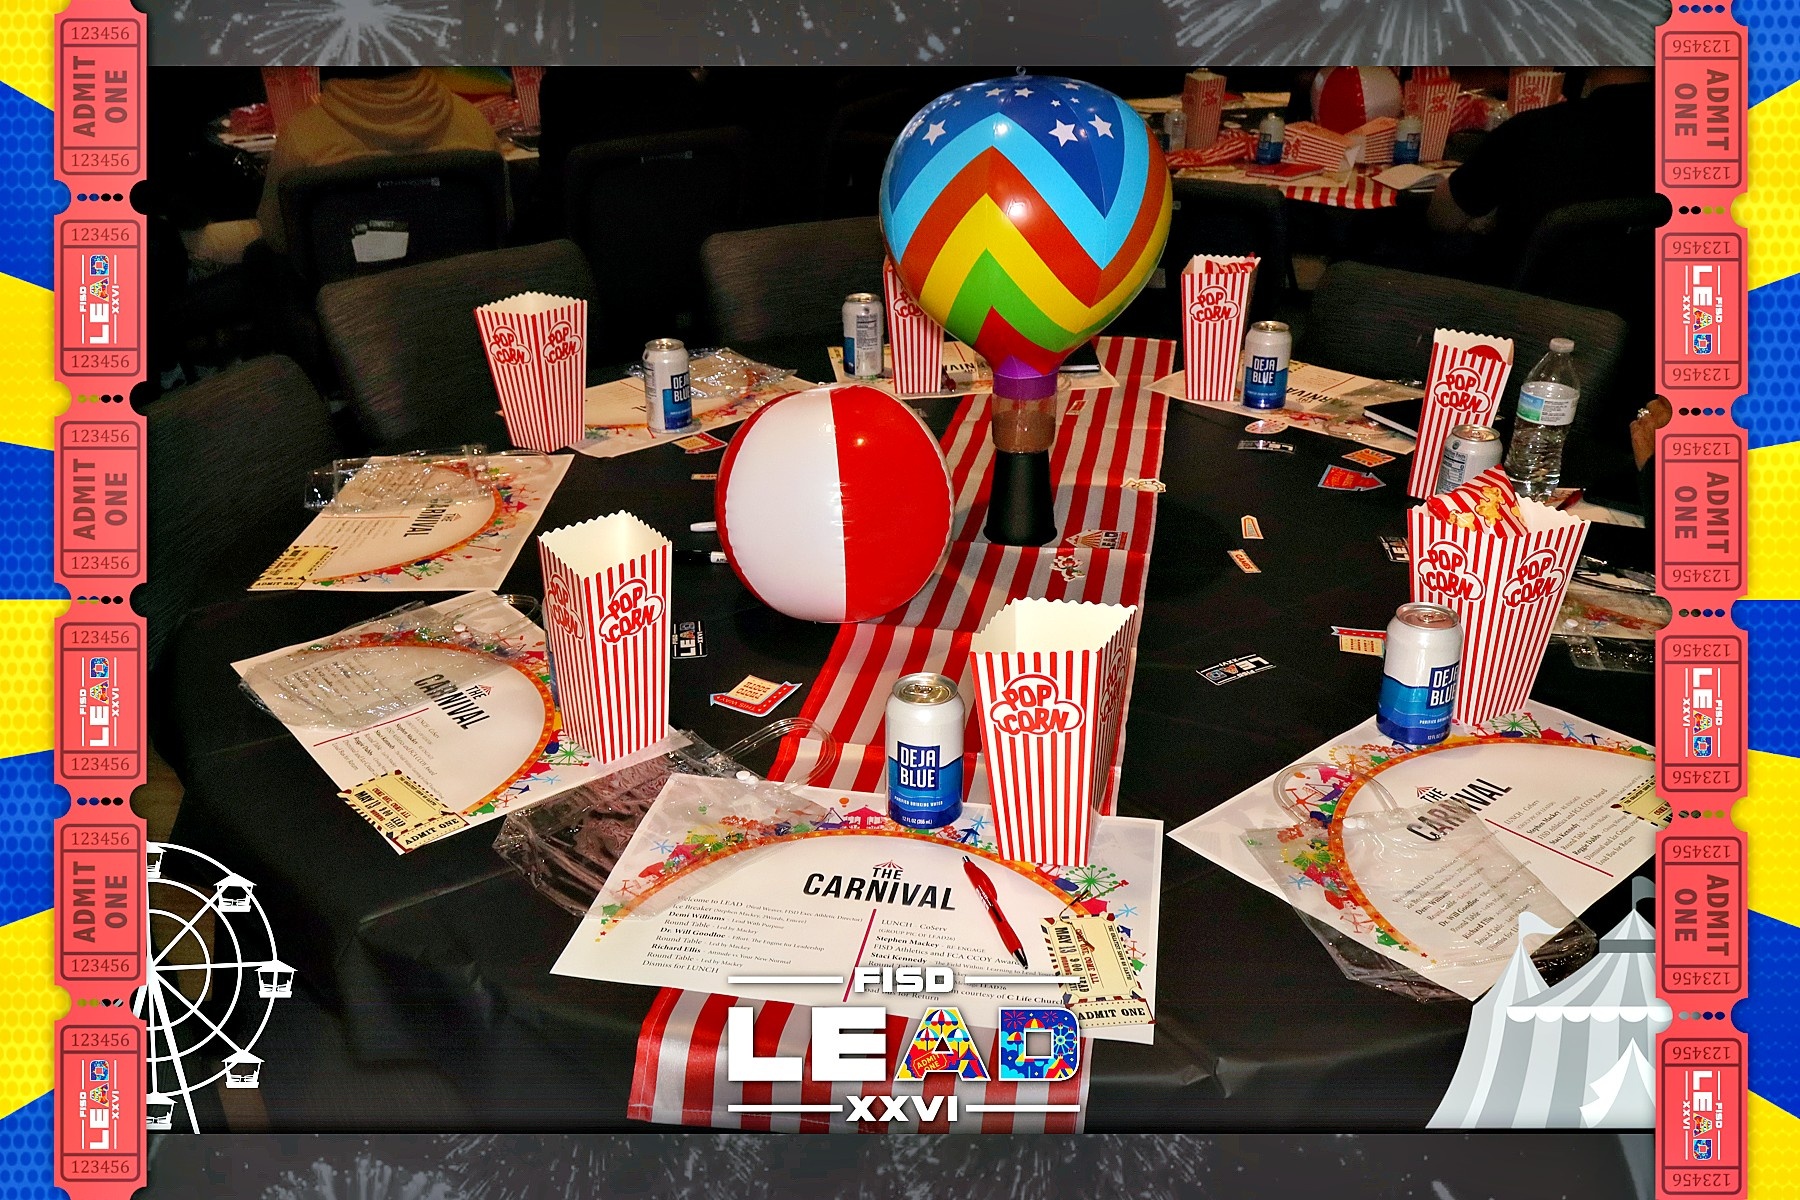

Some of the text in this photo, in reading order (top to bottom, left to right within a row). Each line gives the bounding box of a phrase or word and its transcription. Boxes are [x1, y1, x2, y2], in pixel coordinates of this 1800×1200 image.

[1197, 292, 1224, 308] POP
[1196, 305, 1232, 322] CORN
[493, 333, 514, 349] POP
[548, 327, 569, 347] POP
[496, 348, 525, 364] CORN
[549, 341, 577, 364] CORN
[1254, 358, 1275, 371] DEJA
[1252, 371, 1274, 384] BLUE
[1445, 374, 1477, 392] POP
[1440, 391, 1485, 414] CORN
[1427, 549, 1463, 572] POP
[1517, 557, 1552, 585] POP
[1426, 571, 1474, 600] CORN
[1510, 577, 1557, 607] CORN
[608, 586, 643, 620] POP
[608, 605, 655, 643] CORN
[680, 621, 696, 656] LEAD
[1205, 657, 1269, 680] LEAD
[465, 685, 487, 700] THE
[1002, 684, 1052, 711] POP
[413, 673, 490, 730] CARNIVAL
[1003, 708, 1070, 735] CORN
[901, 746, 935, 767] DEJA
[901, 766, 935, 788] BLUE
[354, 790, 374, 804] MAY
[1420, 788, 1448, 804] THE
[1407, 778, 1512, 841] CARNIVAL
[405, 818, 460, 845] ADMIT ONE
[872, 867, 903, 880] THE
[803, 873, 955, 911] CARNIVAL
[685, 904, 712, 912] Breaker
[720, 899, 743, 907] LEAD
[692, 913, 725, 921] Williams
[881, 919, 913, 927] LUNCH
[683, 937, 702, 945] Table
[692, 930, 726, 938] Goodloe
[875, 935, 940, 948] Stephen Mackey
[1055, 926, 1073, 944] MAY
[647, 951, 673, 959] Round
[651, 943, 682, 951] Richard
[873, 943, 894, 951] FISD
[895, 946, 929, 955] Athletics
[892, 954, 928, 964] Kennedy
[686, 964, 719, 973] LUNCH
[960, 990, 994, 999] courtesy
[1016, 995, 1032, 1003] Life
[1078, 1007, 1145, 1020] ADMIT ONE
